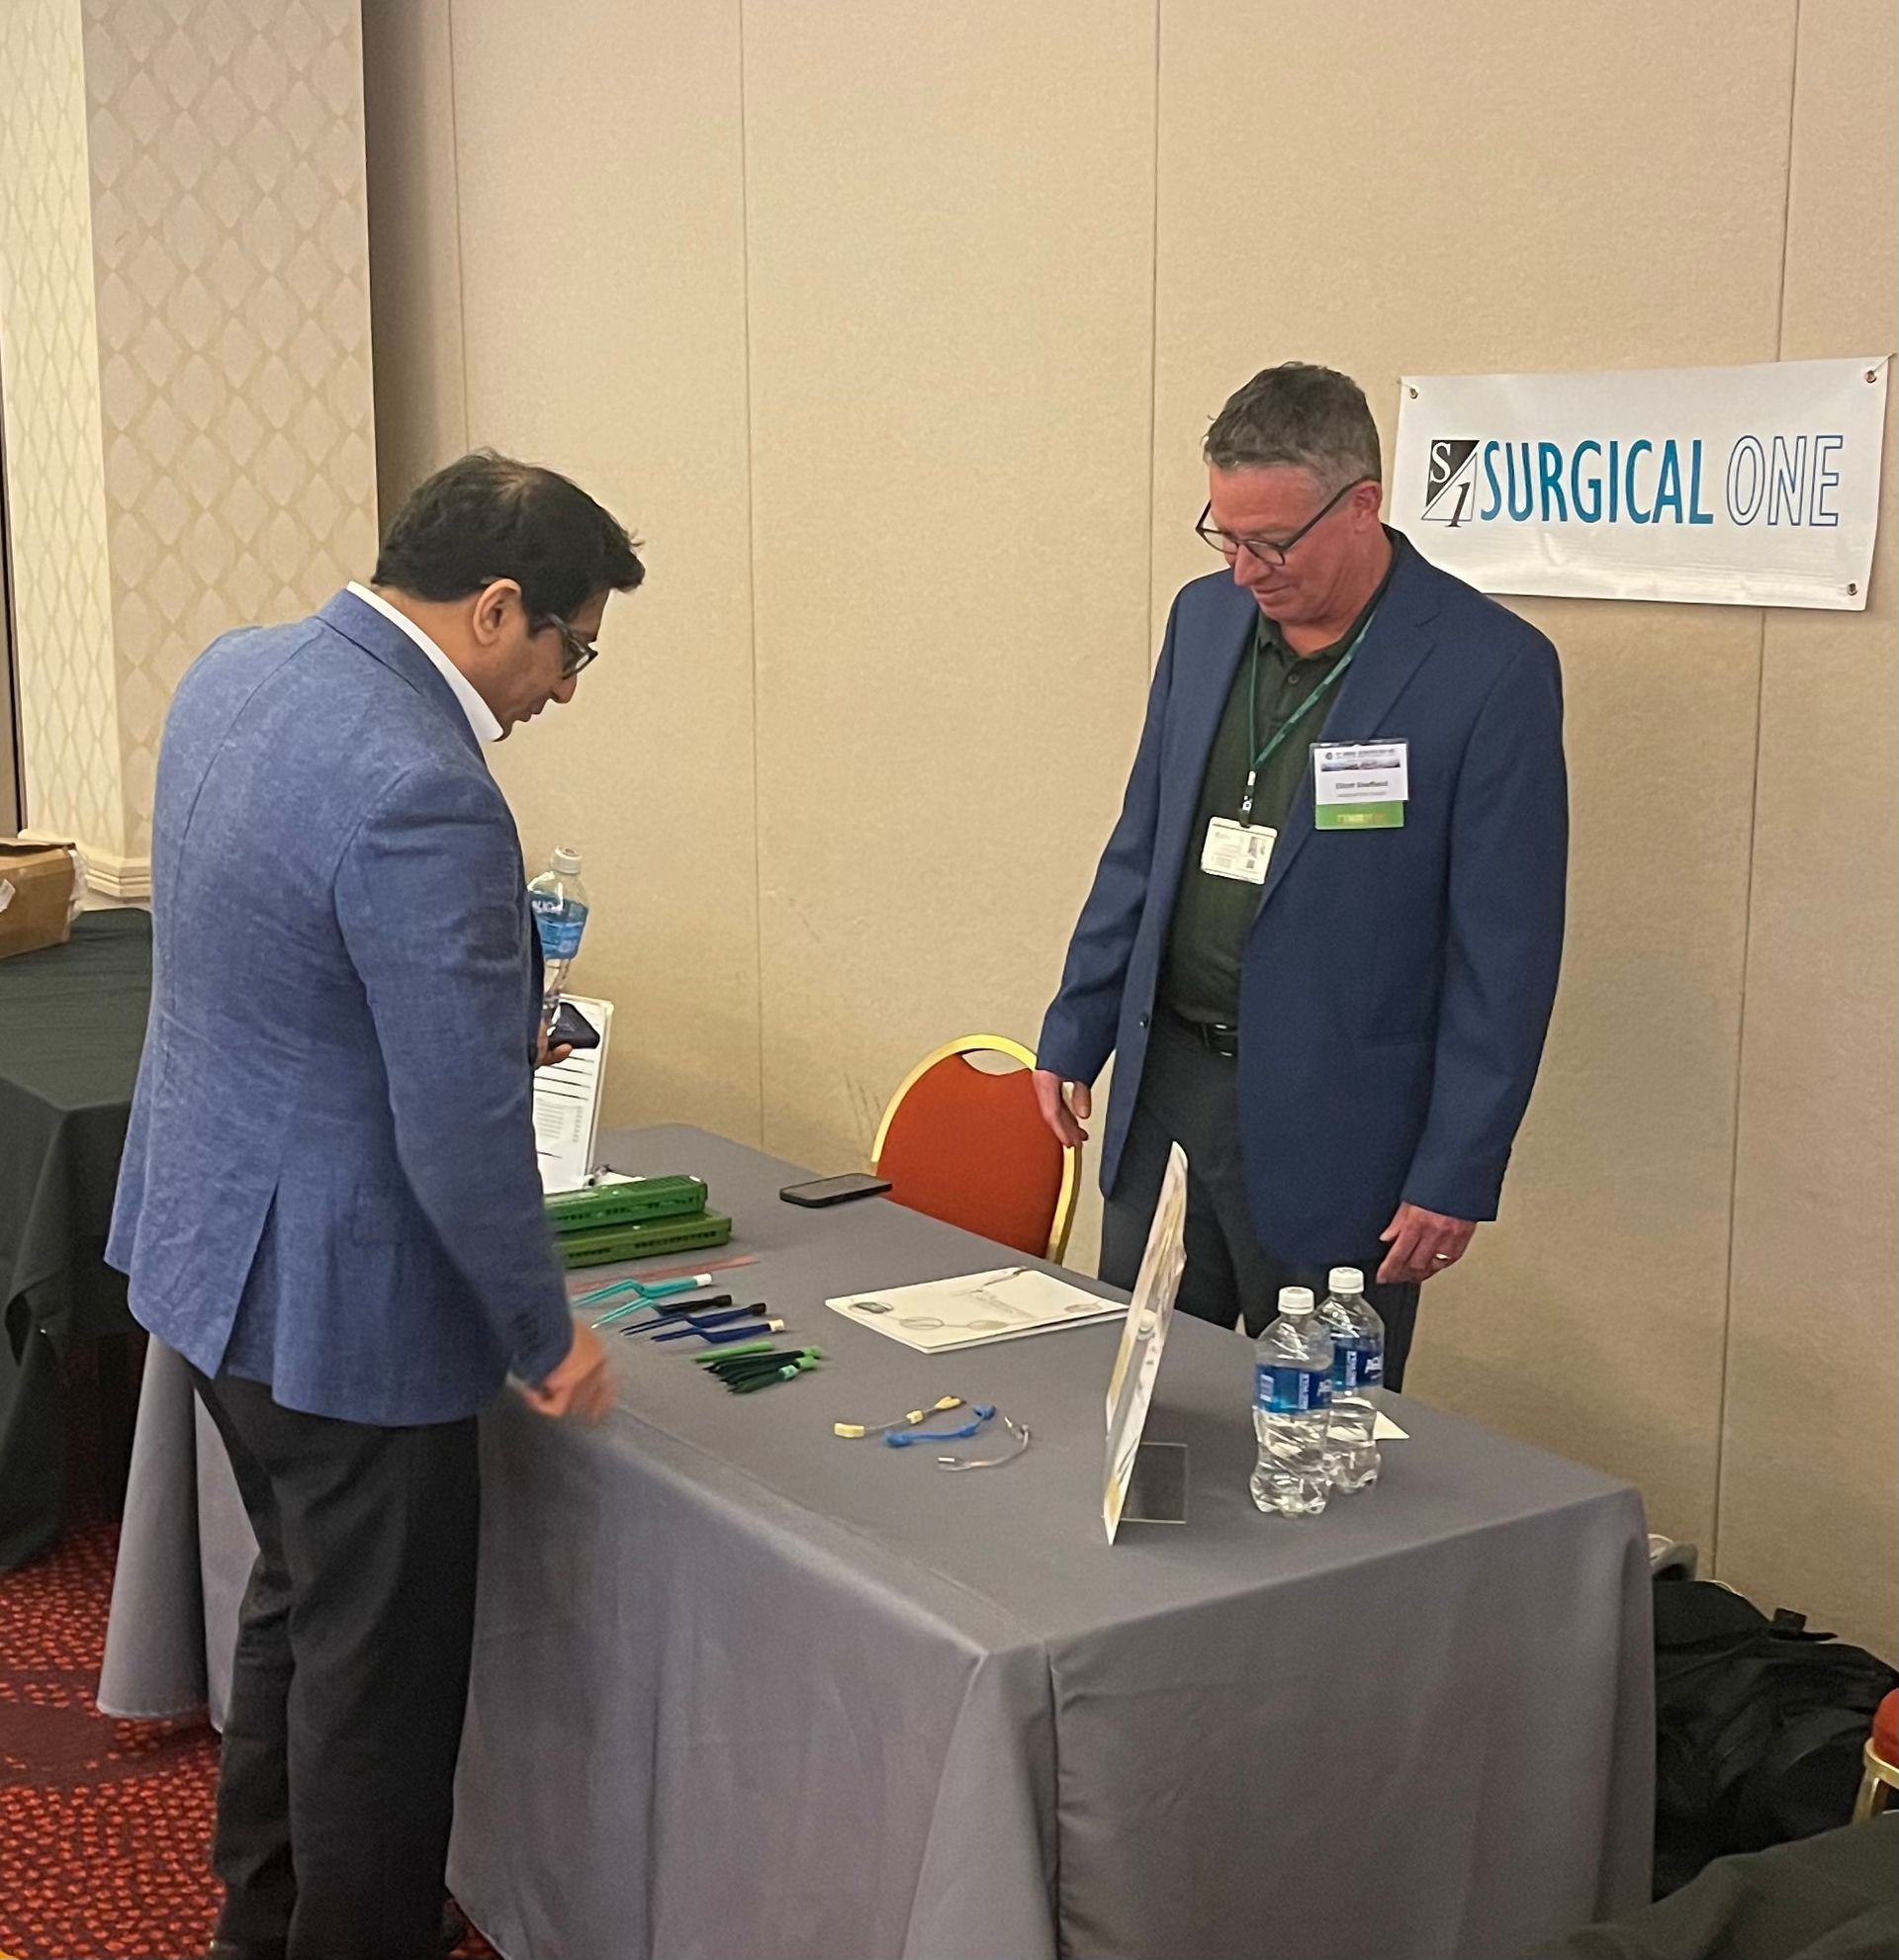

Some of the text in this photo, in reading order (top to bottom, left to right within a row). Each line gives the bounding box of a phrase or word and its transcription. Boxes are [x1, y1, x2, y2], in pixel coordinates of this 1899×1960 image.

[1429, 442, 1451, 484] S
[1481, 434, 1844, 527] SURGICAL ONE
